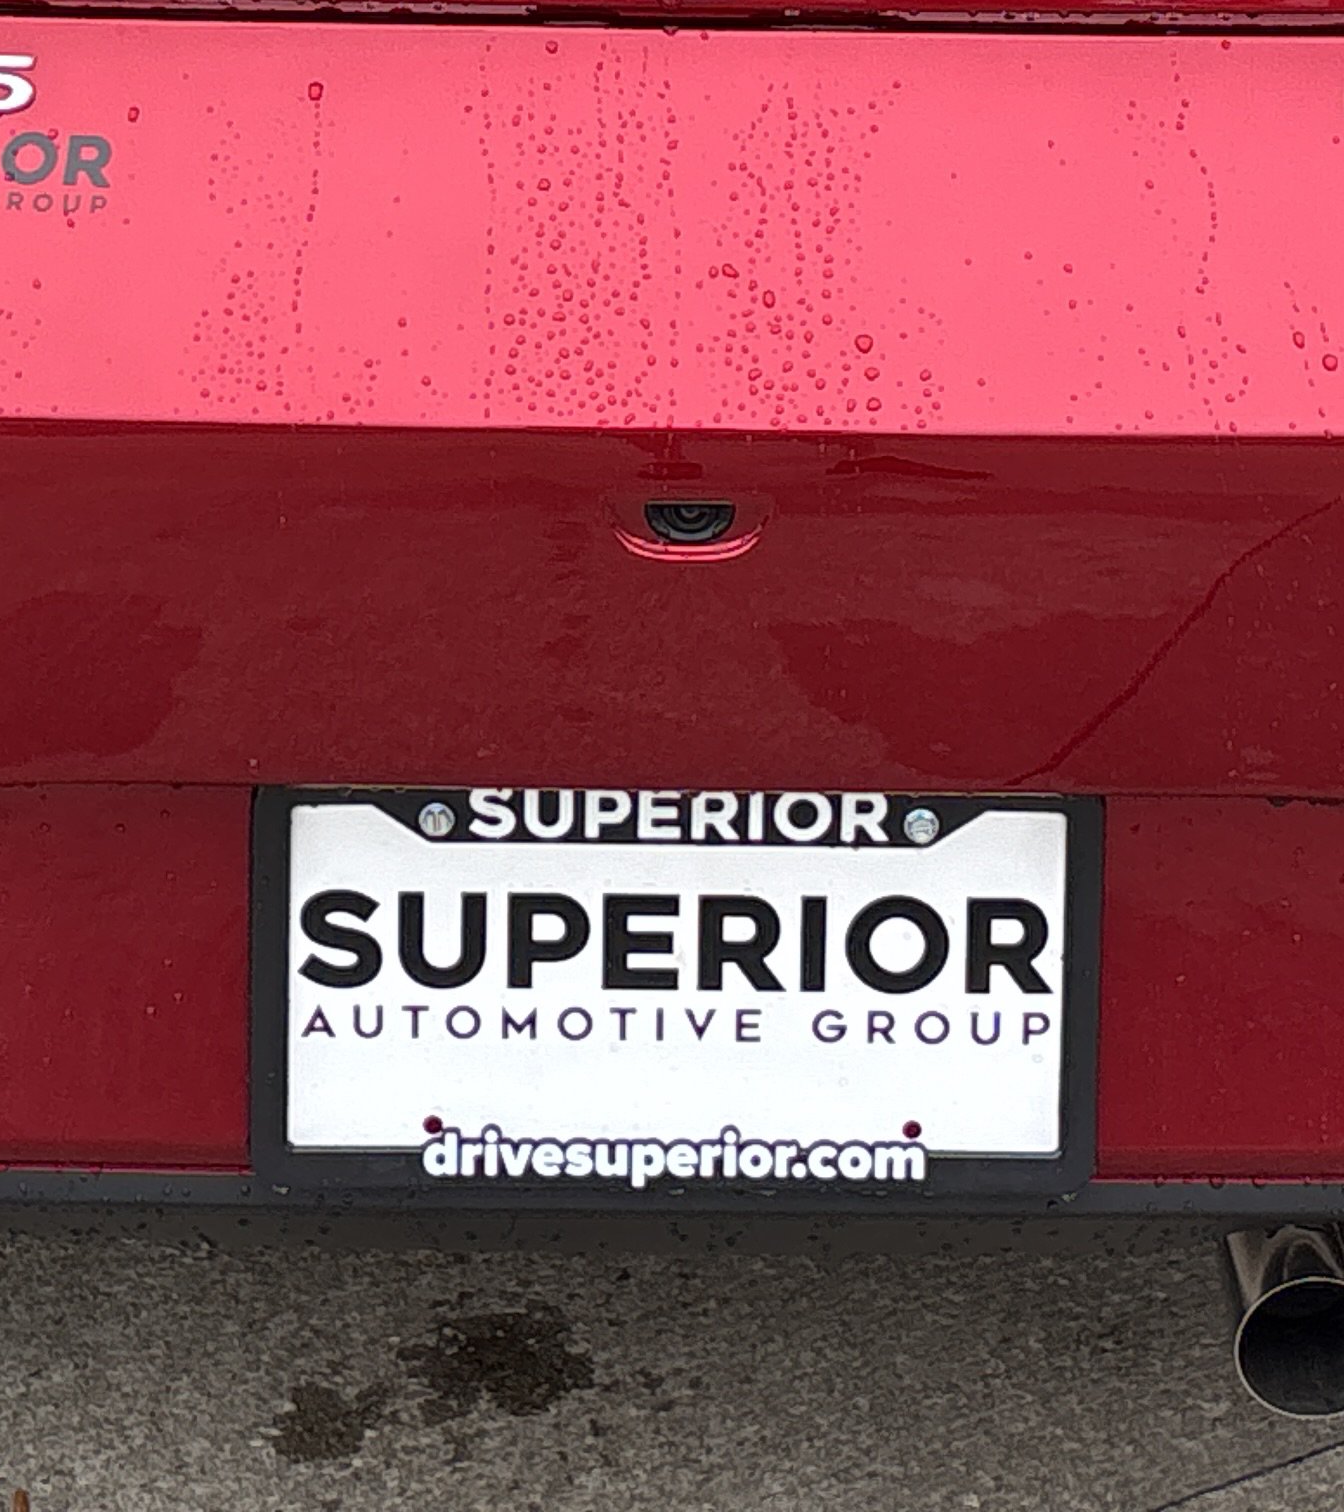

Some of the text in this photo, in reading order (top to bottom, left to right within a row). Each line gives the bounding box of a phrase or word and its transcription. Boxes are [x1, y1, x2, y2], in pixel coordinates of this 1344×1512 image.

[468, 788, 890, 842] SUPERIOR
[298, 889, 1054, 995] SUPERIOR
[301, 1003, 1052, 1047] AUTOMOTIVE GROUP
[422, 1127, 926, 1188] drivesuperior.com
